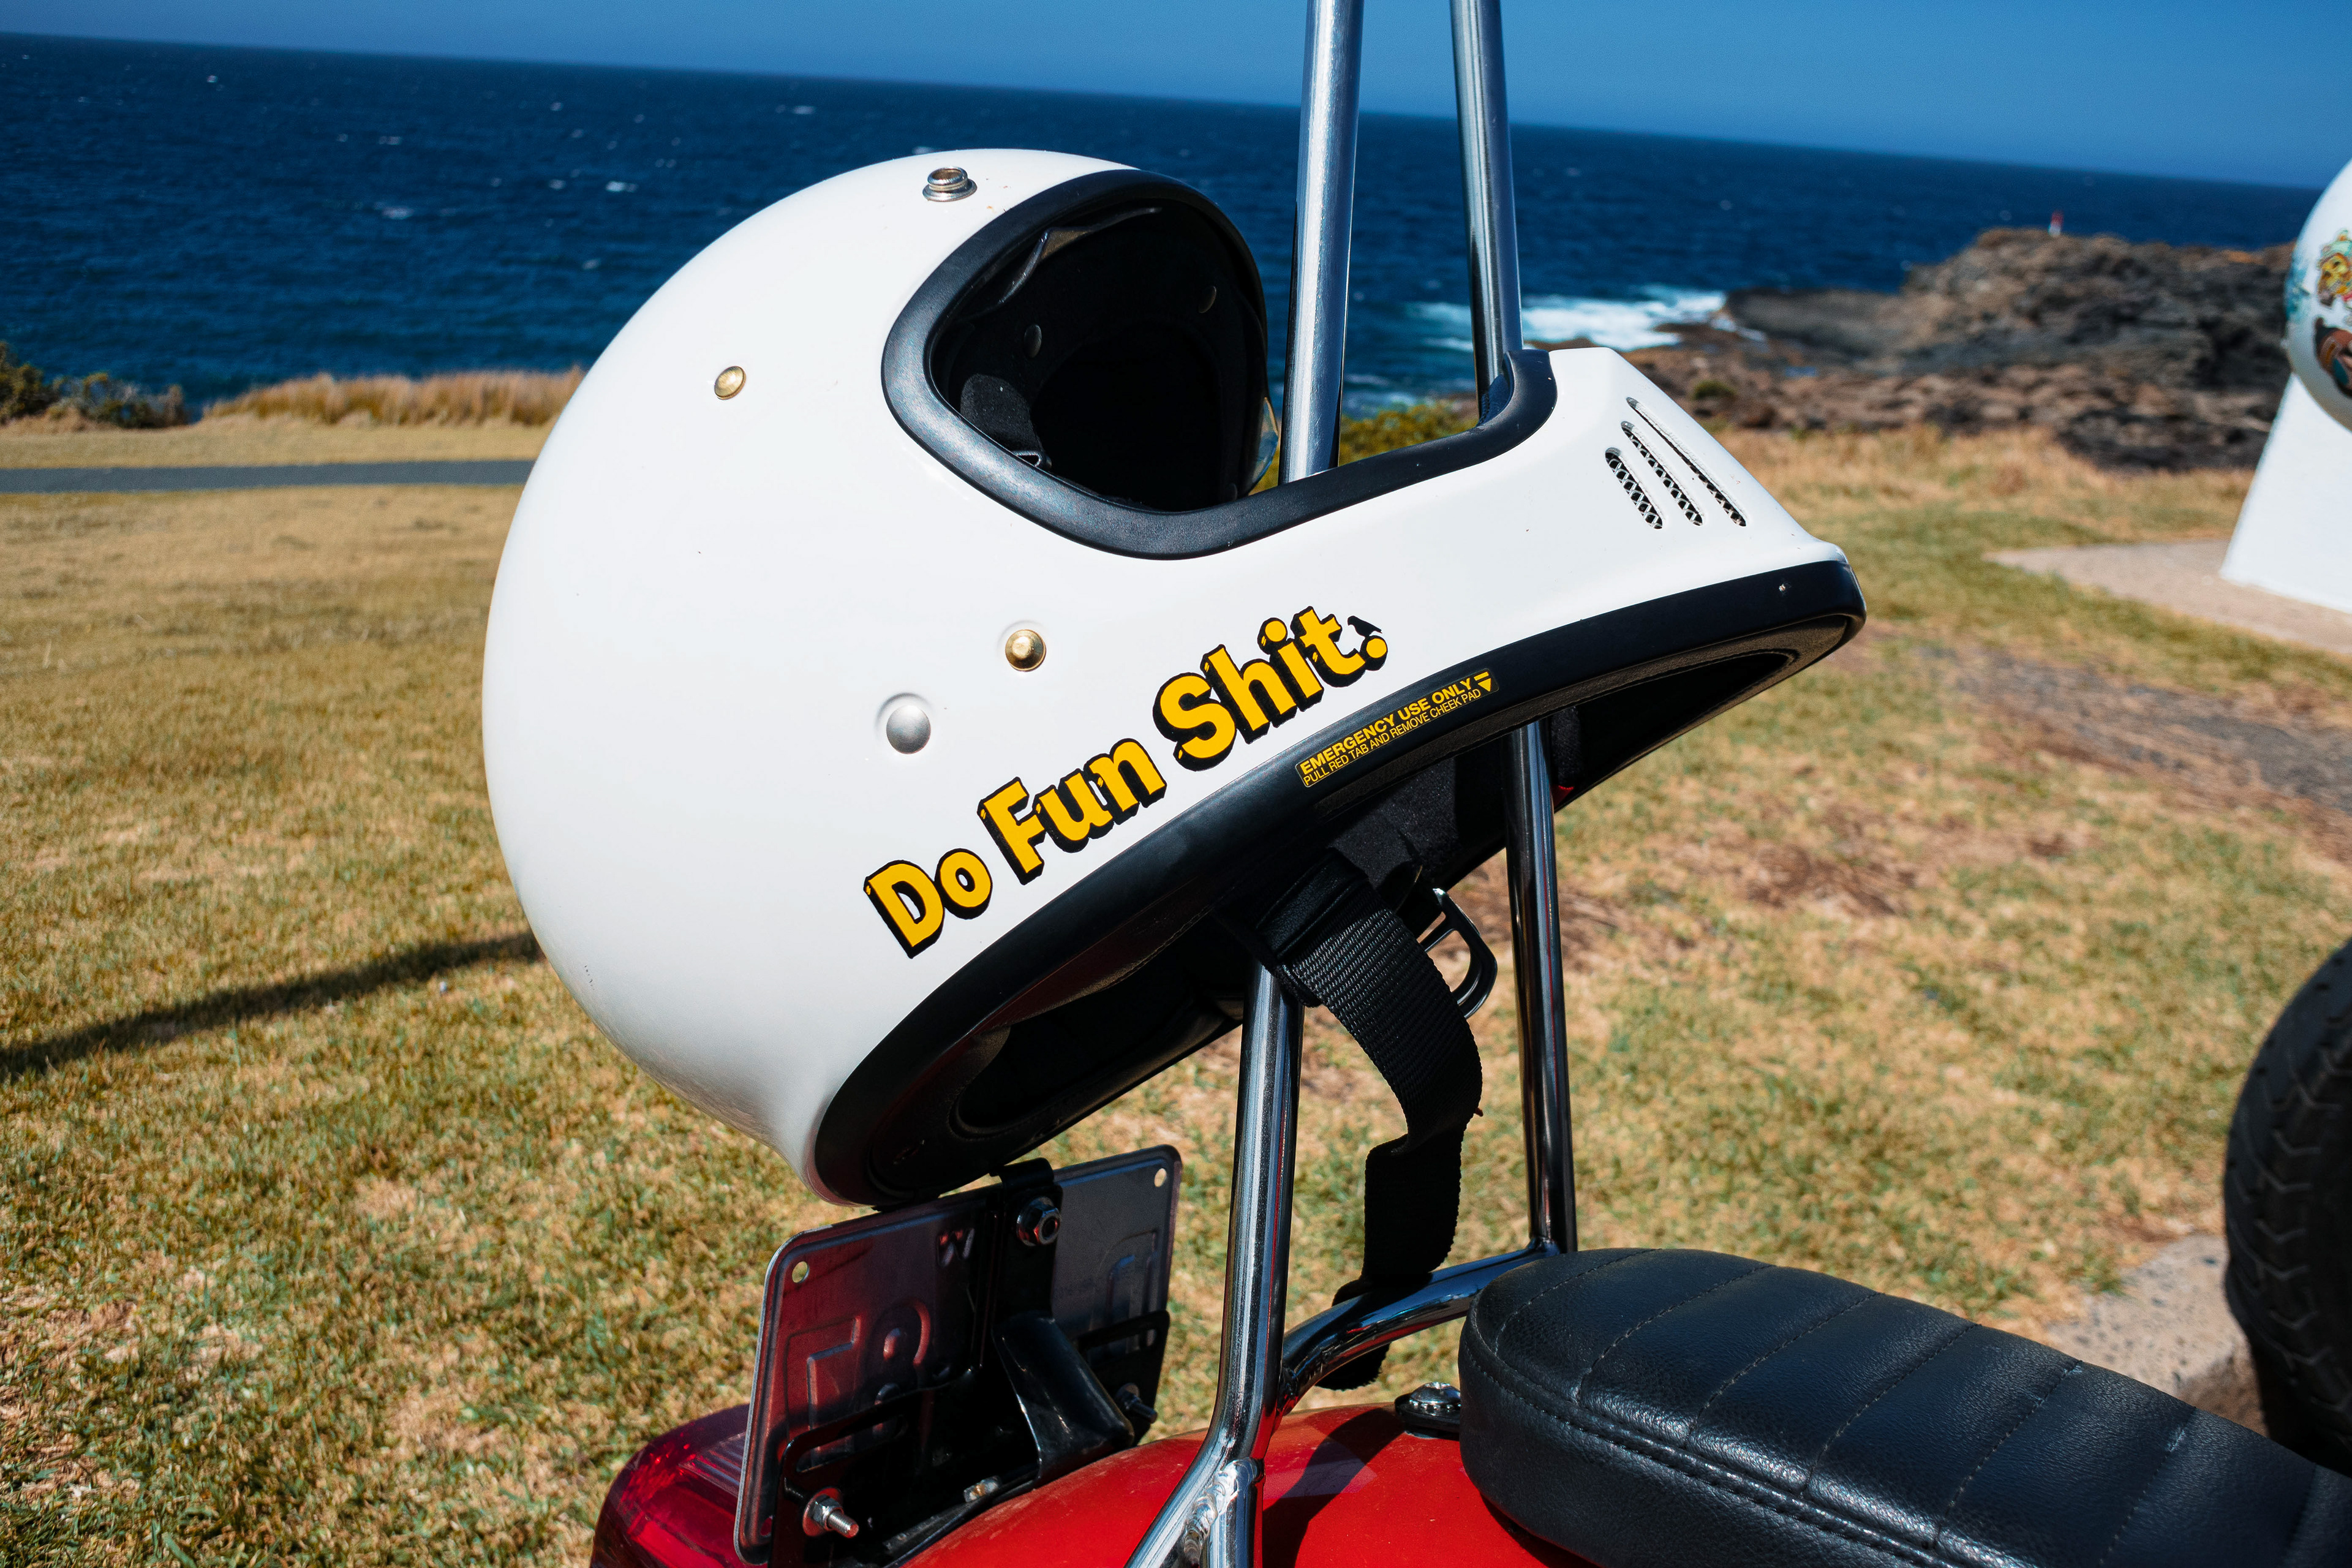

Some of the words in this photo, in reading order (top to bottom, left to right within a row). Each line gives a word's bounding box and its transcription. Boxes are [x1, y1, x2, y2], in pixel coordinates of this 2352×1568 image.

[1300, 714, 1395, 775] EMERGENCY
[1397, 698, 1431, 720] USE
[1431, 677, 1471, 704] ONLY
[1303, 767, 1330, 786] PULL
[1328, 755, 1349, 772] RED
[1348, 744, 1369, 758] TAB
[1370, 733, 1390, 750] AND
[1389, 712, 1430, 738] REMOVE
[1430, 697, 1462, 718] CHEEK
[1461, 688, 1481, 704] PAD
[864, 848, 992, 959] Do
[978, 738, 1167, 885] Fun
[1152, 606, 1388, 771] Shit.
